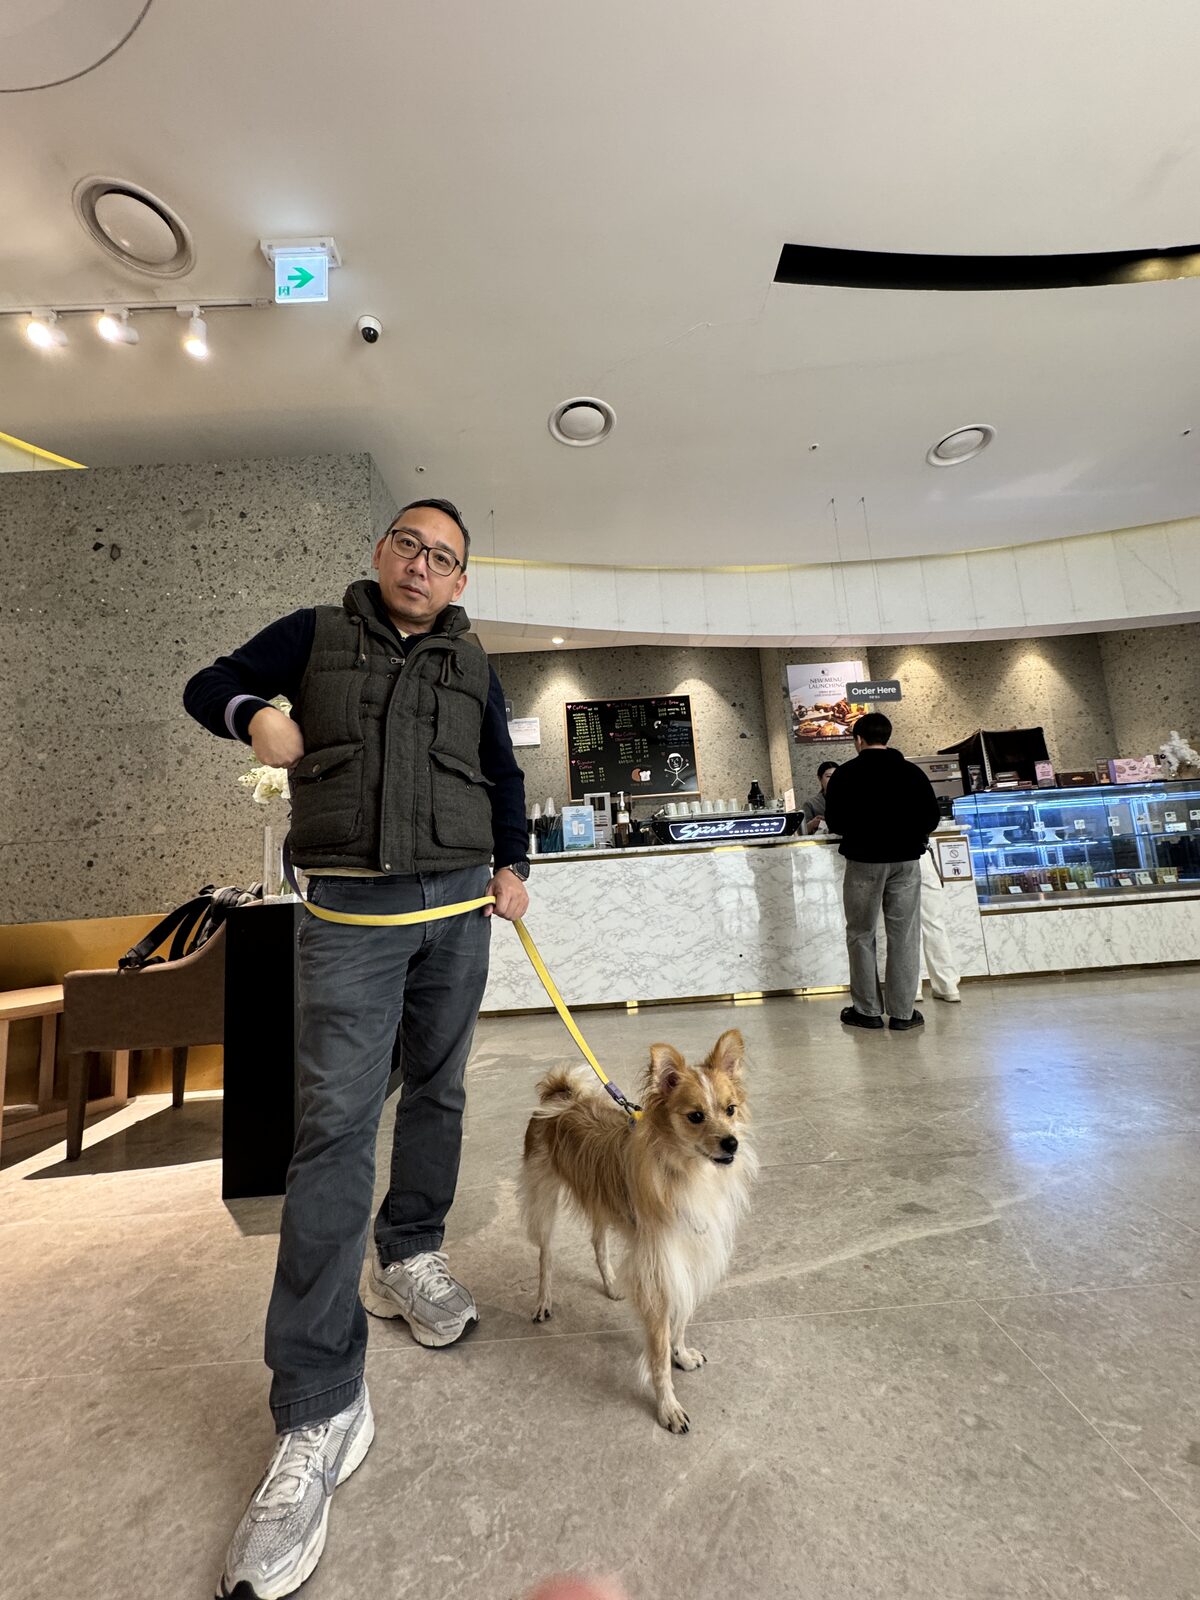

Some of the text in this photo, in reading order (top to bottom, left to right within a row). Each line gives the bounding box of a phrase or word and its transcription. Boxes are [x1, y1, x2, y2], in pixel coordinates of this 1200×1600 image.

[808, 682, 845, 690] LAUNCHING
[851, 687, 876, 696] Order
[876, 686, 897, 694] Here
[679, 821, 736, 839] Spirit
